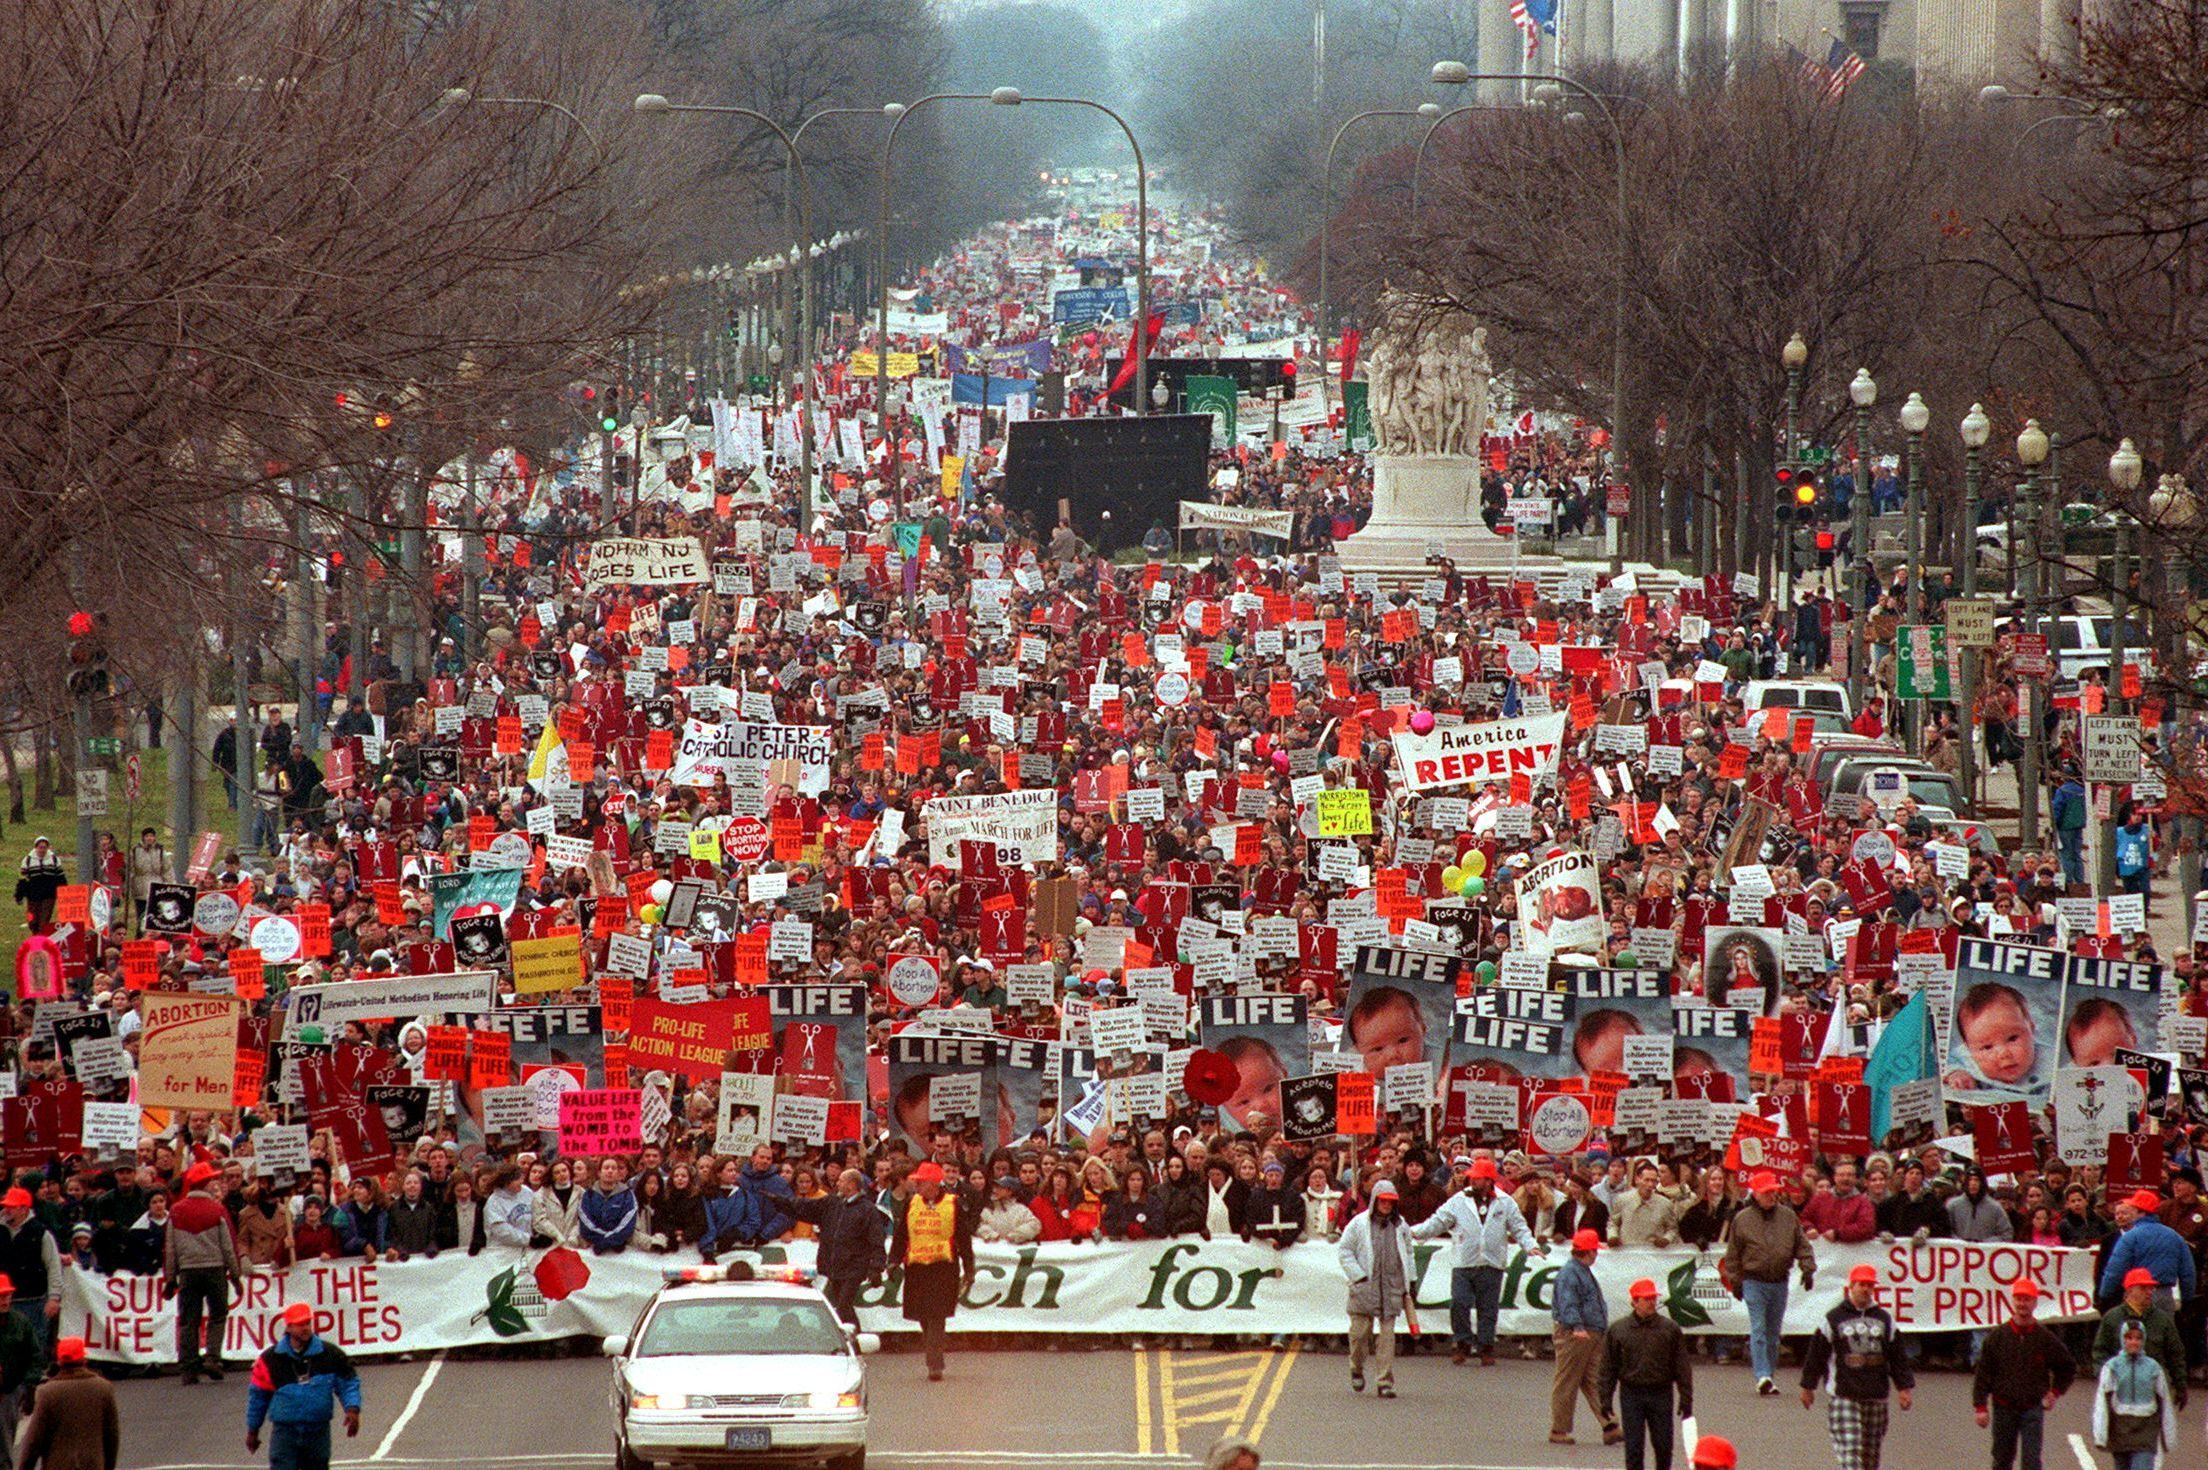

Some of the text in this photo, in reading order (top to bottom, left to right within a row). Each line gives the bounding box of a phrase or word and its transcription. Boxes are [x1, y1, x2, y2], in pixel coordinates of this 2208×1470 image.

[1205, 509, 1249, 521] NATIONAL
[662, 543, 690, 558] NJ
[648, 563, 697, 579] LIFE
[718, 565, 748, 575] JESUS
[1972, 605, 1991, 613] LANE
[1957, 619, 1983, 628] MUST
[2090, 720, 2137, 729] LEFT LANE
[713, 724, 810, 743] ST. PETER
[1441, 726, 1528, 750] America
[2098, 735, 2129, 745] MUST
[682, 739, 833, 765] CATHOLIC CHURCH
[2089, 750, 2137, 758] TURN LEFT
[1414, 744, 1557, 785] REPENT
[2094, 759, 2132, 768] AT NEXT
[2087, 770, 2137, 779] INTERSECTION
[928, 791, 1055, 812] SAINT BENEDICT
[1319, 791, 1365, 800] MORRISTOWN
[1320, 801, 1335, 809] New
[1322, 811, 1369, 831] loves Life!
[729, 825, 761, 836] STOP
[970, 821, 1008, 840] MARCH
[1013, 827, 1032, 841] FOR
[1036, 820, 1055, 838] LIFE
[726, 833, 767, 846] ABORTION
[733, 844, 762, 855] NOW
[997, 848, 1022, 862] 98
[1521, 853, 1594, 895] ABORTION
[602, 914, 626, 928] LIFE!
[1434, 909, 1460, 921] Face
[456, 917, 480, 933] Face
[1365, 949, 1449, 982] LIFE
[1969, 942, 2053, 978] LIFE
[132, 961, 157, 974] LIFE!
[896, 967, 933, 980] Stop All
[1504, 967, 1534, 975] children
[2077, 959, 2150, 992] LIFE
[893, 979, 934, 993] Abortion!
[1577, 971, 1660, 997] LIFE
[433, 989, 470, 1001] Honoring
[472, 989, 487, 999] Life
[600, 990, 632, 1000] CHOICE
[769, 988, 853, 1015] LIFE
[607, 1002, 631, 1016] LIFE!
[1212, 997, 1295, 1026] LIFE
[1508, 991, 1565, 1020] IFE
[146, 1002, 230, 1028] ABORTION
[61, 1019, 86, 1034] Face
[652, 1016, 706, 1040] PRO-LIFE
[1094, 1025, 1126, 1034] children
[1674, 1010, 1737, 1037] IFE
[1465, 1016, 1550, 1054] LIFE
[429, 1039, 466, 1049] CHOICE
[629, 1035, 726, 1066] ACTION LEAGUE
[1098, 1040, 1128, 1048] women
[900, 1038, 985, 1065] LIFE
[434, 1053, 467, 1068] LIFE!
[479, 1059, 510, 1075] LIFE!
[2121, 1055, 2148, 1067] Face
[1823, 1071, 1862, 1082] CHOICE
[164, 1075, 228, 1093] for Men
[375, 1088, 404, 1101] Face
[1339, 1085, 1374, 1098] CHOICE
[563, 1092, 640, 1107] VALUE LIFE
[573, 1108, 635, 1122] from the
[797, 1107, 818, 1115] more
[1346, 1100, 1375, 1117] LIFE!
[1542, 1107, 1568, 1122] Stop
[776, 1111, 824, 1122] children die
[562, 1123, 632, 1136] WOMB to
[777, 1127, 820, 1139] women cry
[794, 1122, 816, 1131] more
[1536, 1124, 1586, 1138] Abortion!
[564, 1138, 641, 1151] the TOMB
[1762, 1138, 1799, 1154] STOP
[1888, 1246, 2070, 1286] SUPPORT
[1137, 1243, 1283, 1310] for
[309, 1265, 379, 1304] THE
[83, 1314, 154, 1354] LIFE
